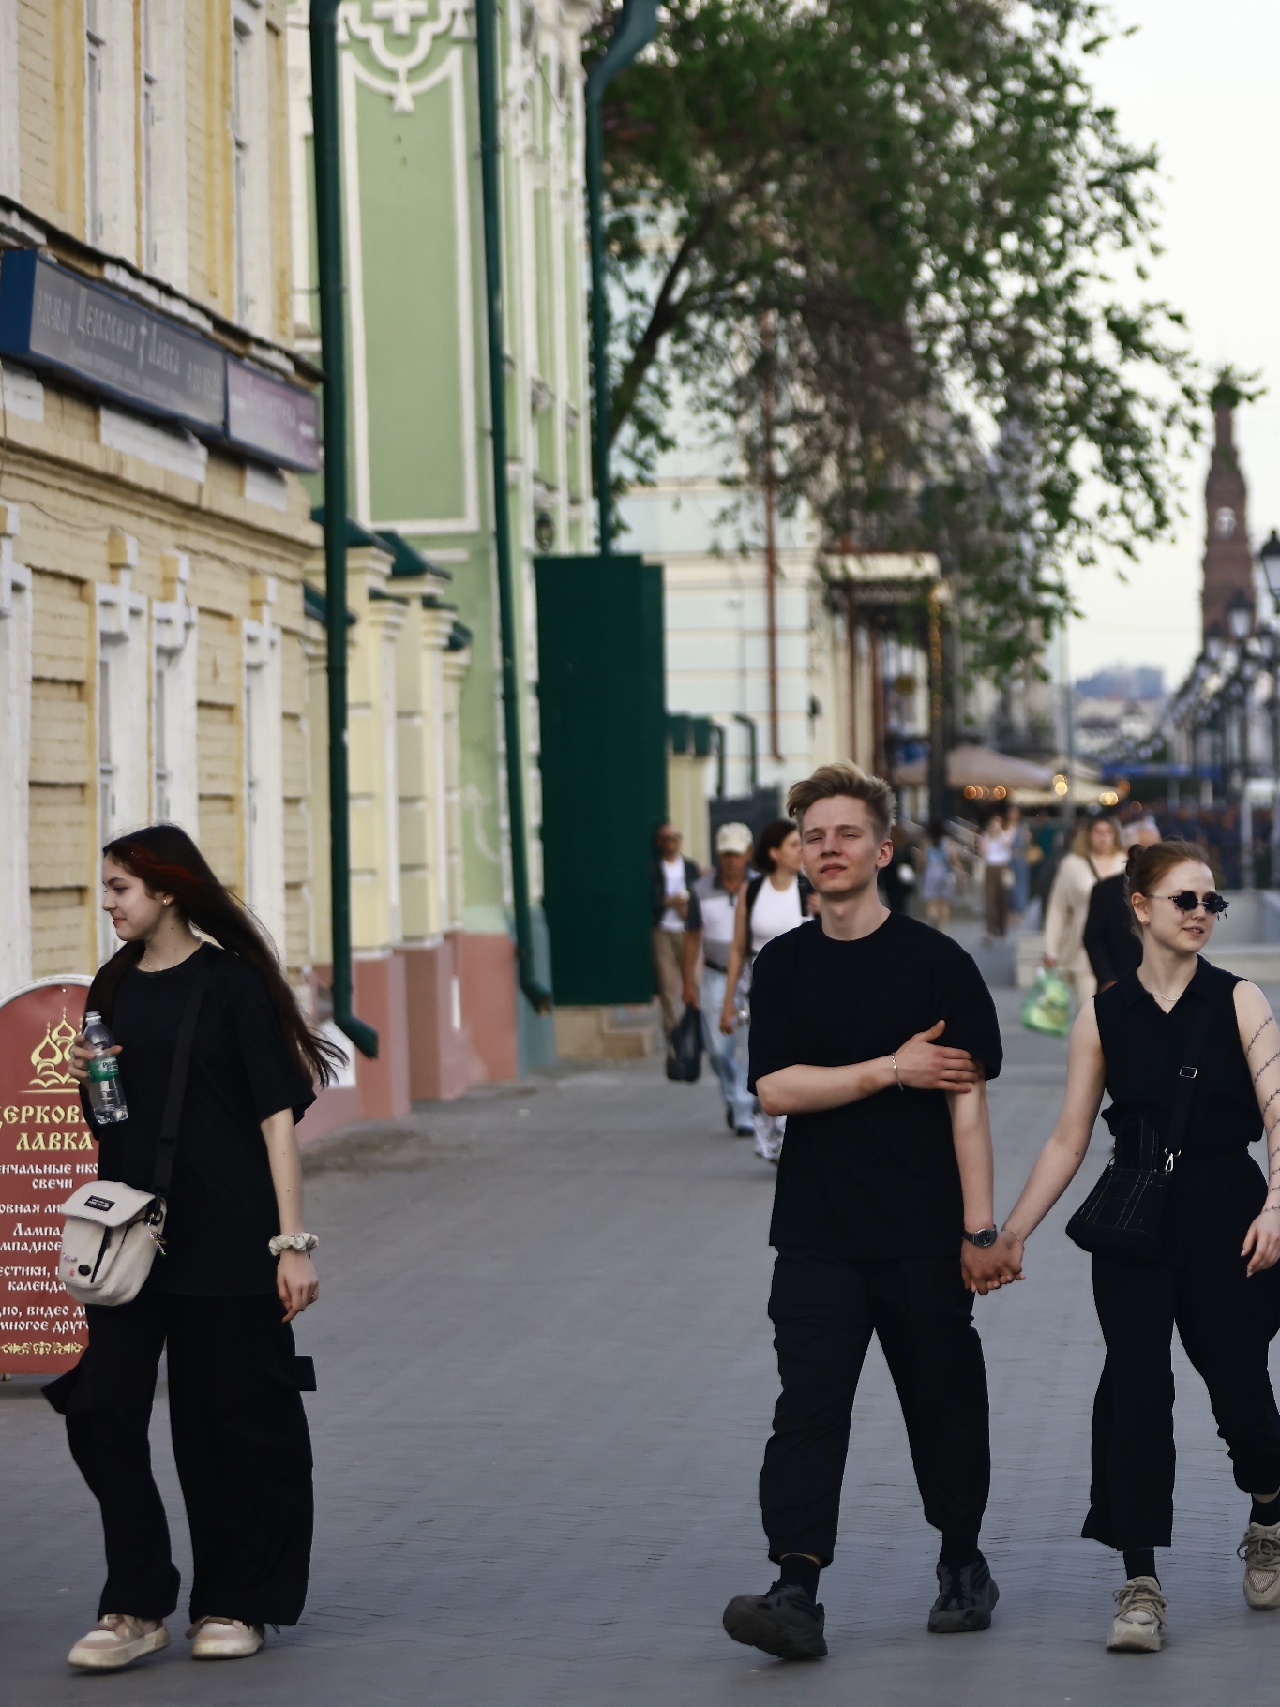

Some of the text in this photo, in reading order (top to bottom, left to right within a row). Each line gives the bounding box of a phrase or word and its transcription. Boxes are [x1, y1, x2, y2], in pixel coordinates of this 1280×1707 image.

[0, 1104, 87, 1128] ЕРКОВ
[16, 1131, 94, 1151] ЛАВКА
[0, 1203, 40, 1214] овная
[12, 1222, 63, 1237] Лампа
[0, 1241, 62, 1253] мпадное
[8, 1281, 68, 1294] календа
